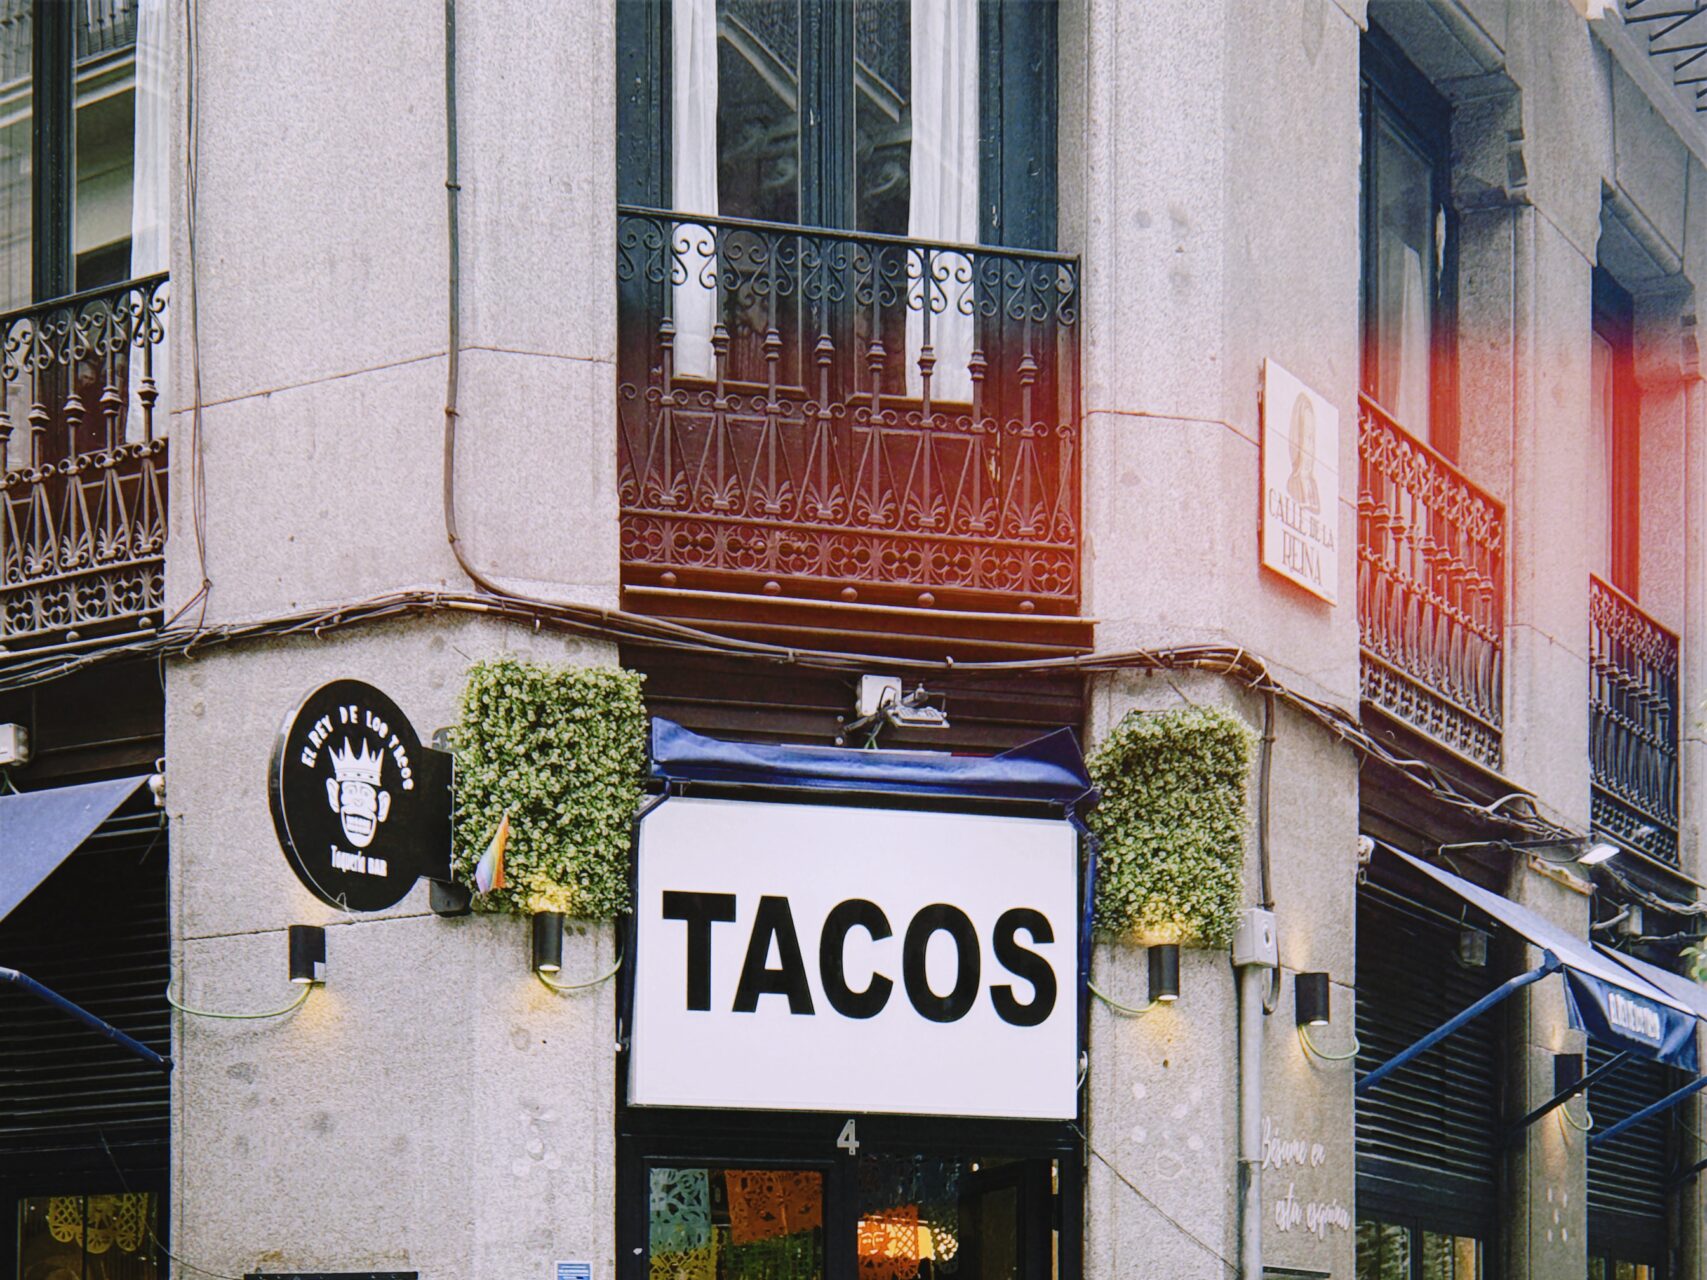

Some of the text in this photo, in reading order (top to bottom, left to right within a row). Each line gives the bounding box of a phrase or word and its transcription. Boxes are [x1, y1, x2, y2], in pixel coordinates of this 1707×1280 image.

[1269, 488, 1307, 536] CALLE
[1323, 523, 1335, 552] LA
[1282, 530, 1323, 587] REINA
[308, 714, 334, 749] REY
[339, 705, 358, 724] DE
[366, 710, 389, 738] LOS
[388, 734, 414, 790] TACOS
[662, 890, 1057, 1027] TACOS
[837, 1119, 860, 1155] 4
